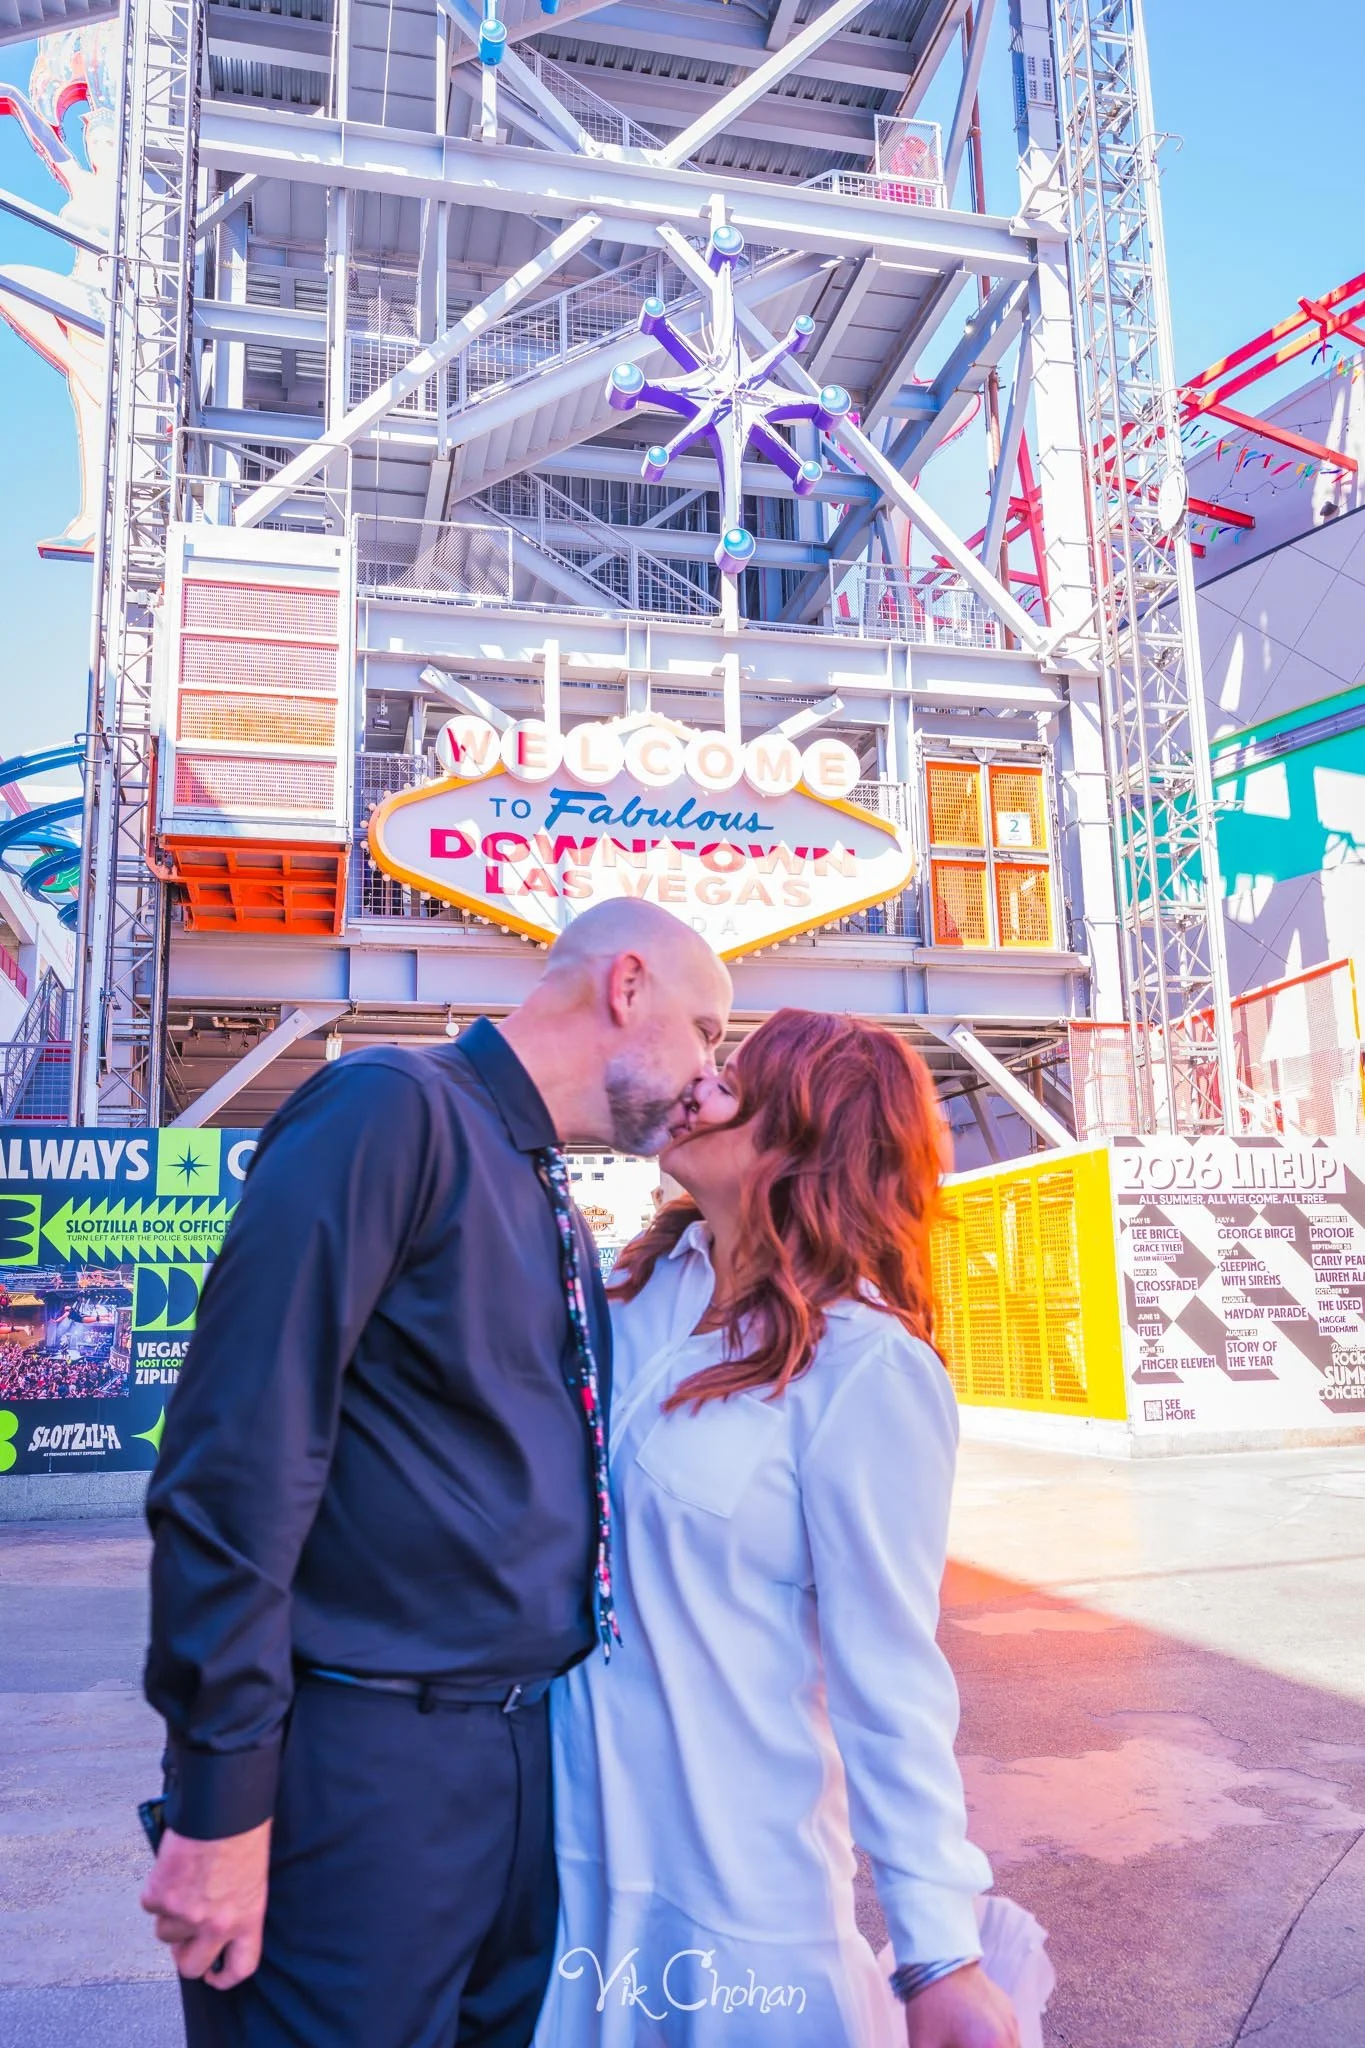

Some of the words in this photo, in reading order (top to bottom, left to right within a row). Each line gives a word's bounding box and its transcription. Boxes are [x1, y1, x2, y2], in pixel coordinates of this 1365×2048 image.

[447, 726, 847, 786] WELCOME
[489, 797, 531, 819] TO
[544, 787, 774, 831] Fabulous
[1010, 819, 1020, 833] 2
[430, 828, 857, 878] DOWNTOWN
[486, 865, 594, 899] LAS
[622, 872, 812, 908] VEGAS
[0, 1138, 149, 1182] LWAYS
[1122, 1152, 1222, 1190] 2026
[1231, 1152, 1338, 1190] LINEUP
[1139, 1195, 1158, 1205] ALL
[1159, 1195, 1206, 1205] SUMMER.
[1207, 1195, 1226, 1204] ALL
[1227, 1194, 1281, 1204] WELCOME.
[1282, 1194, 1300, 1204] ALL
[1300, 1194, 1327, 1204] FREE.
[66, 1219, 138, 1233] SLOTZILLA
[143, 1219, 174, 1233] BOX
[1132, 1229, 1147, 1239] LEE
[1149, 1228, 1180, 1239] BRICE
[1217, 1228, 1262, 1239] GEORGE
[1264, 1228, 1294, 1239] BIRGE
[1311, 1227, 1355, 1238] PROTOJE
[1133, 1244, 1159, 1252] GRACE
[1161, 1243, 1182, 1252] TYLER
[1314, 1255, 1342, 1266] CARLY
[1220, 1261, 1266, 1272] SLEEPING
[1221, 1275, 1246, 1286] WITH
[1248, 1274, 1282, 1286] SIRENS
[1315, 1272, 1350, 1282] LAUREN
[1136, 1280, 1198, 1291] CROSSFADE
[1137, 1296, 1159, 1304] TRAPT
[1317, 1300, 1334, 1310] THE
[1336, 1300, 1361, 1310] USED
[1224, 1308, 1264, 1319] MAYDAY
[1268, 1307, 1307, 1318] PARADE
[1319, 1315, 1346, 1323] MAGGIE
[1139, 1325, 1162, 1336] FUEL
[1320, 1325, 1358, 1333] LINDEMANN
[1227, 1341, 1259, 1353] STORY
[1262, 1341, 1277, 1352] OF
[135, 1359, 160, 1368] MOST
[1142, 1359, 1178, 1370] FINGER
[1180, 1357, 1216, 1368] ELEVEN
[1228, 1356, 1246, 1367] THE
[1248, 1356, 1273, 1367] YEAR
[1164, 1399, 1181, 1410] SEE
[1165, 1409, 1196, 1420] MORE
[27, 1423, 122, 1452] SLOTZILLA
